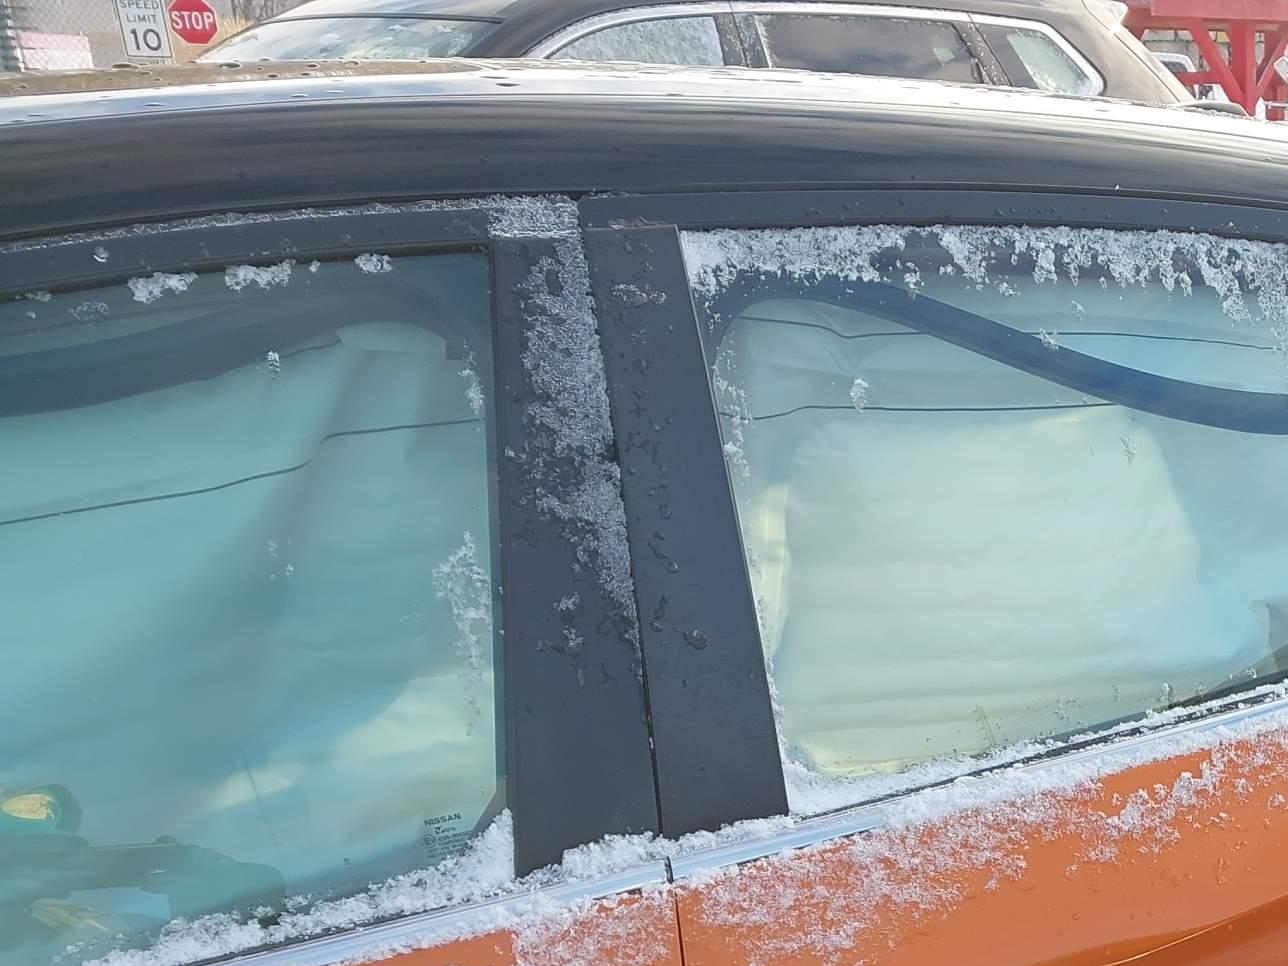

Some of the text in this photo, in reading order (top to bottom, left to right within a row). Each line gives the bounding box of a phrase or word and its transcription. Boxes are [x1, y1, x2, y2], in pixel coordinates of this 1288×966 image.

[119, 0, 160, 10] SPEED
[126, 13, 158, 23] LIMIT
[171, 11, 214, 30] STOP
[130, 28, 161, 51] 10
[424, 812, 462, 827] NISSAN
